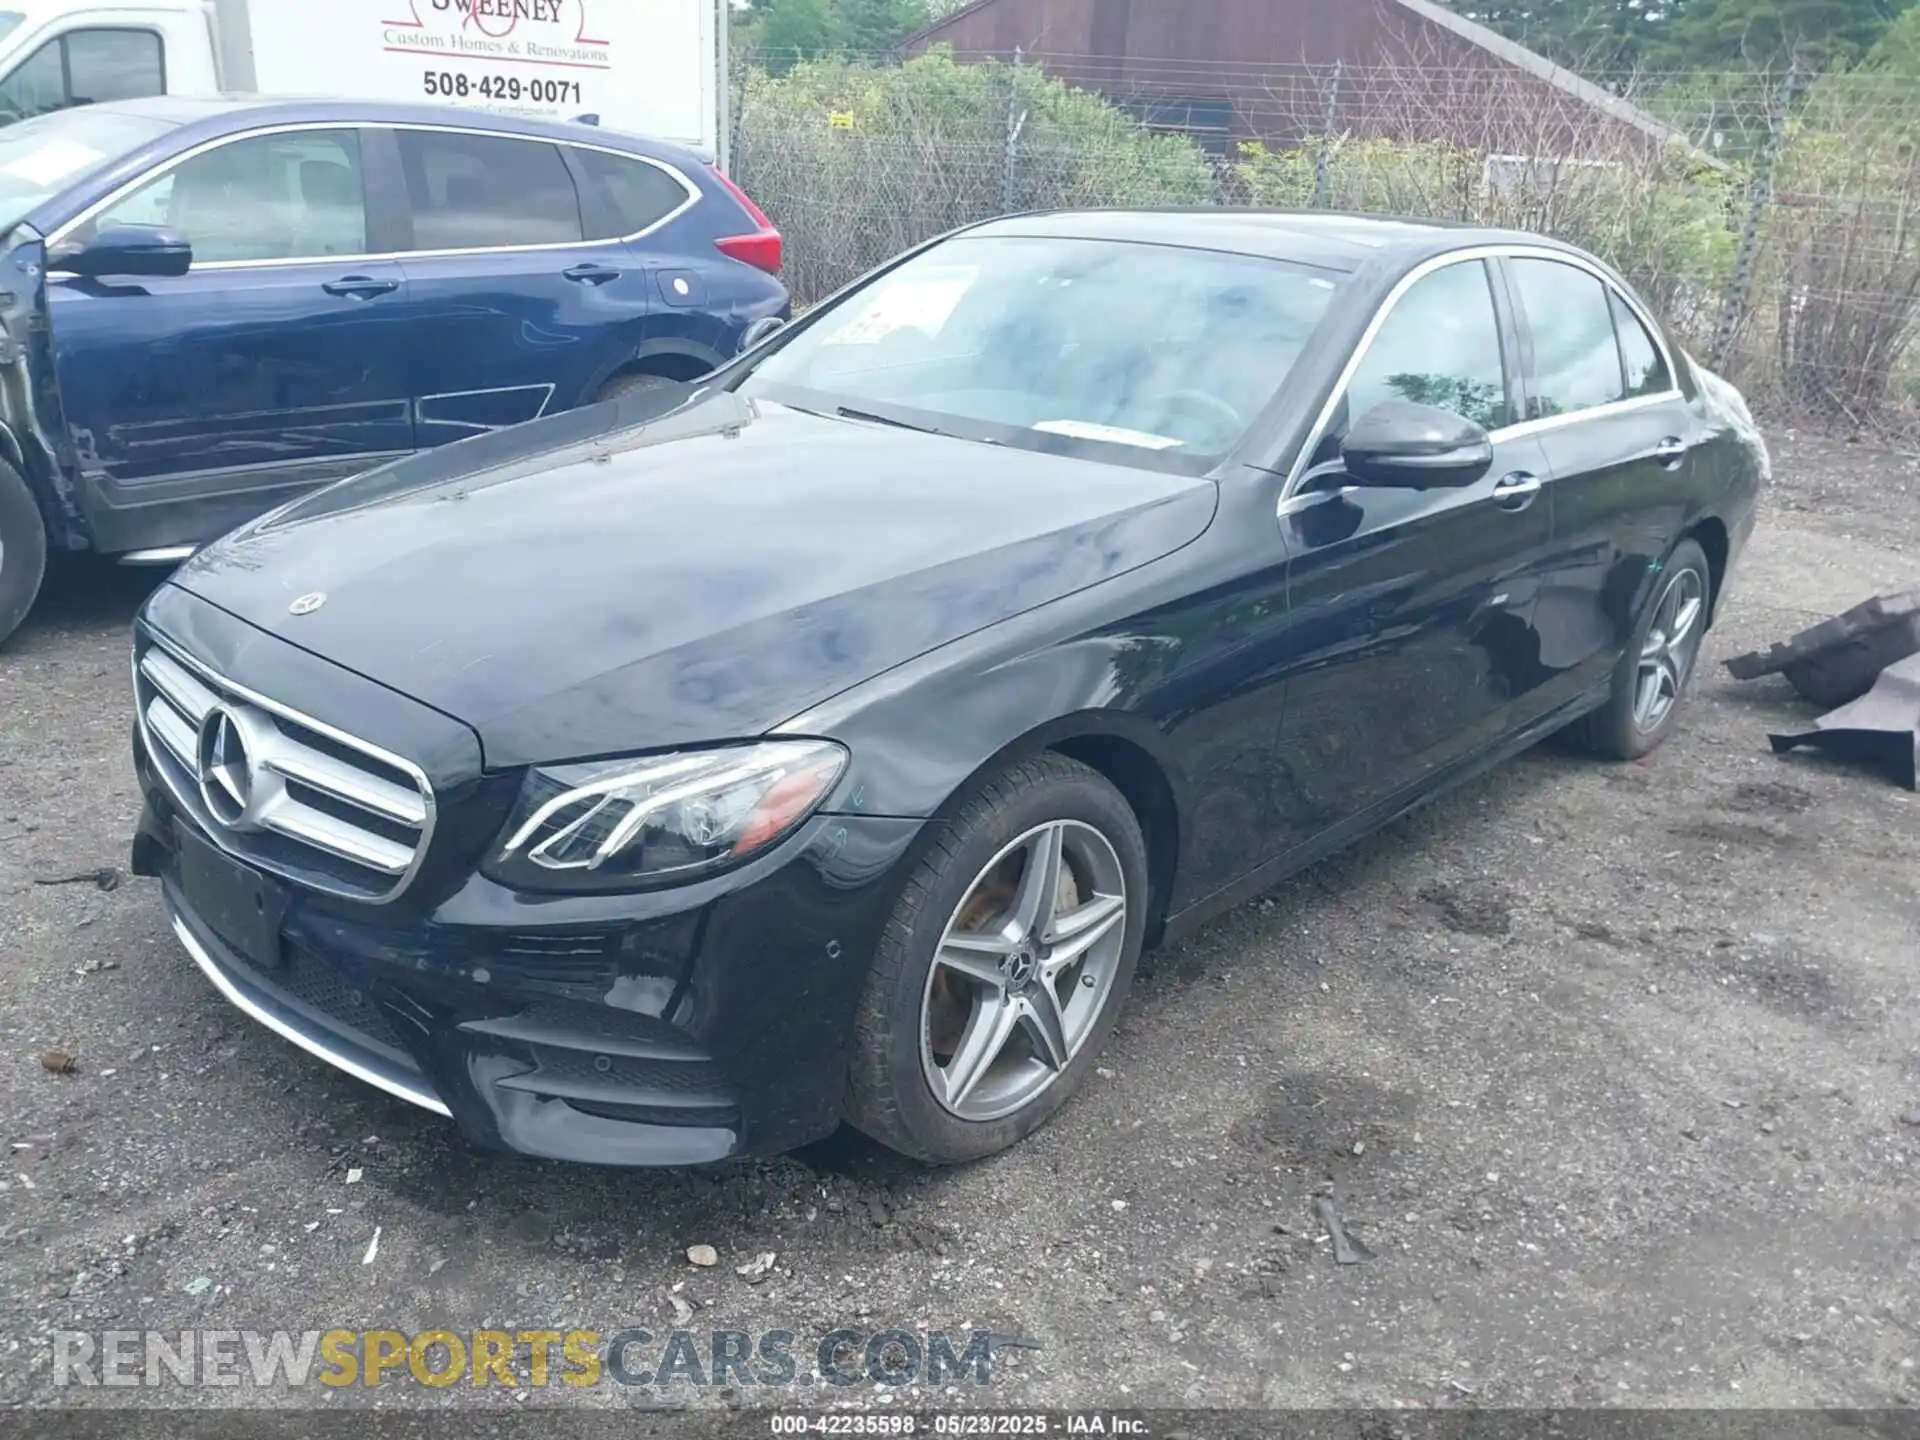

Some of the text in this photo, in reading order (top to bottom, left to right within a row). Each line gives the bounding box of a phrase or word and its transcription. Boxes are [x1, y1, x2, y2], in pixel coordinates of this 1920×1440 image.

[383, 28, 608, 61] Custom Homes & Renovations
[424, 70, 581, 104] 508-429-0071
